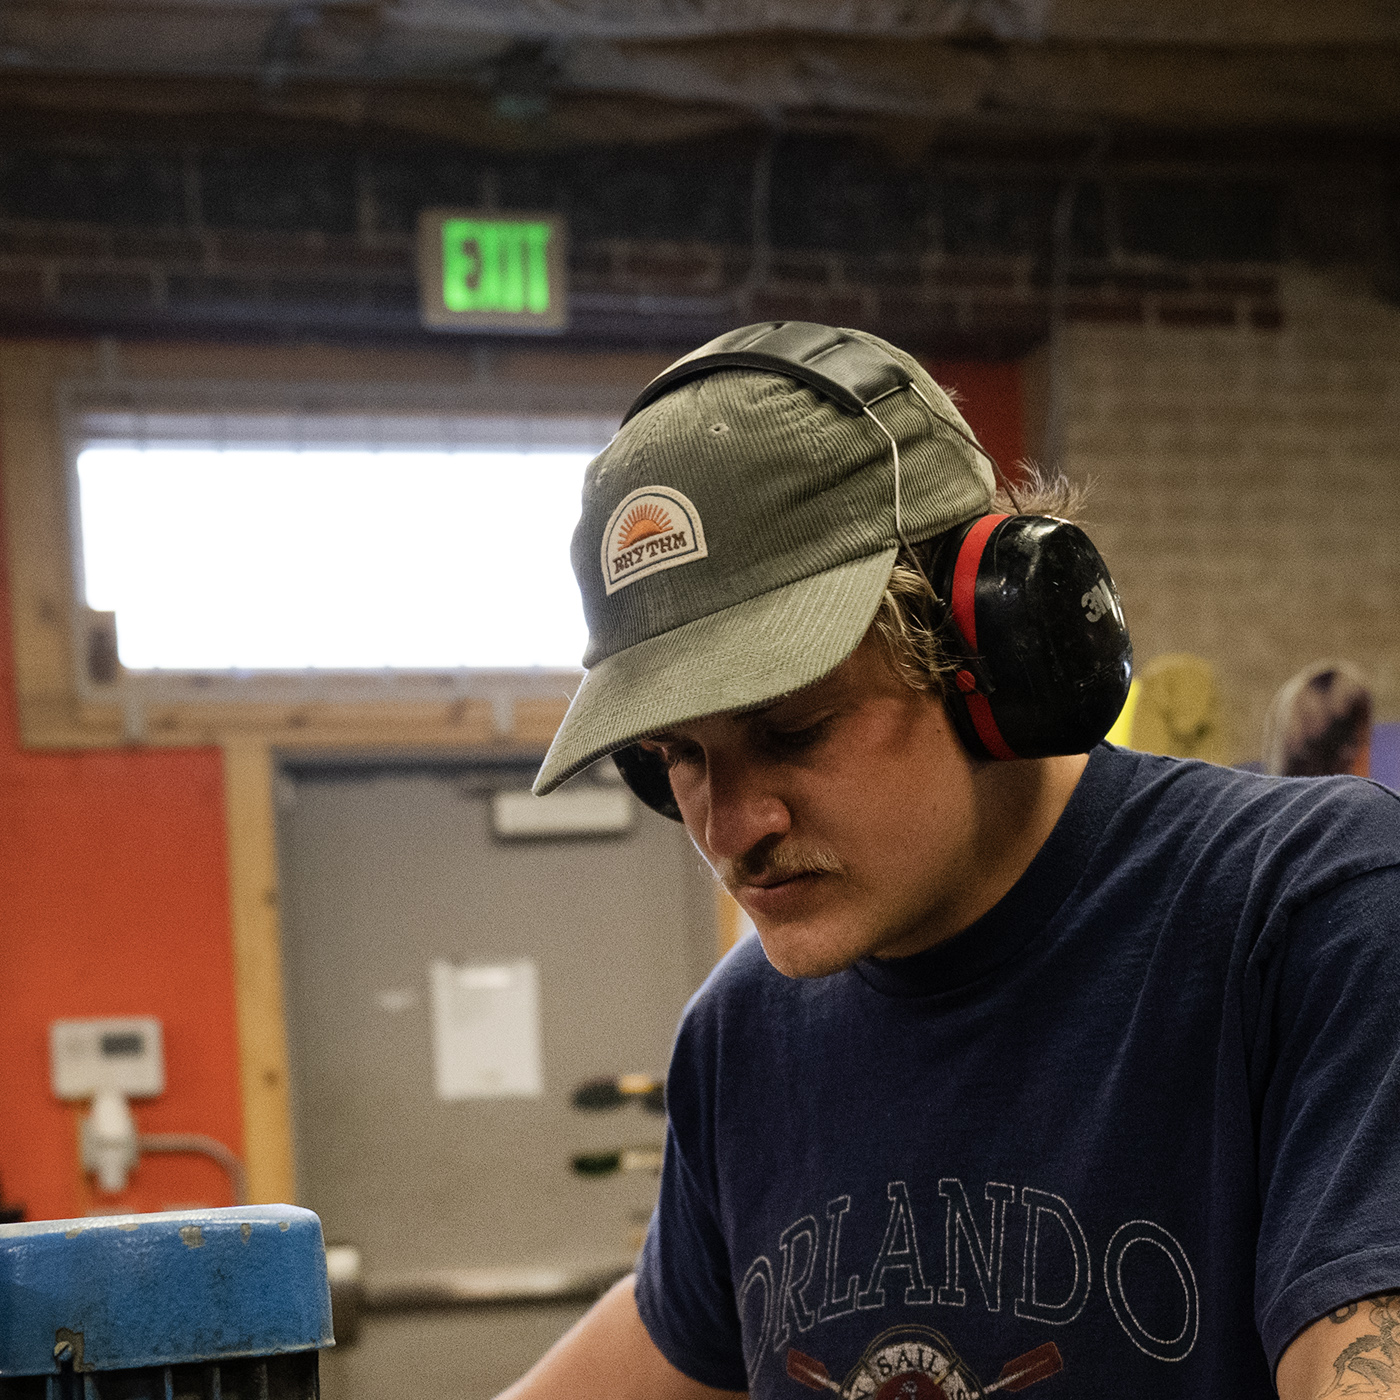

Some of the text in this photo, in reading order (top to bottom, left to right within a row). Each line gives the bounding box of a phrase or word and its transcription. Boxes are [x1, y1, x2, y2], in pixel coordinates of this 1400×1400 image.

[612, 531, 687, 575] RHYTHM
[738, 1178, 1200, 1392] ORLANDO
[876, 1349, 945, 1380] SAIL
